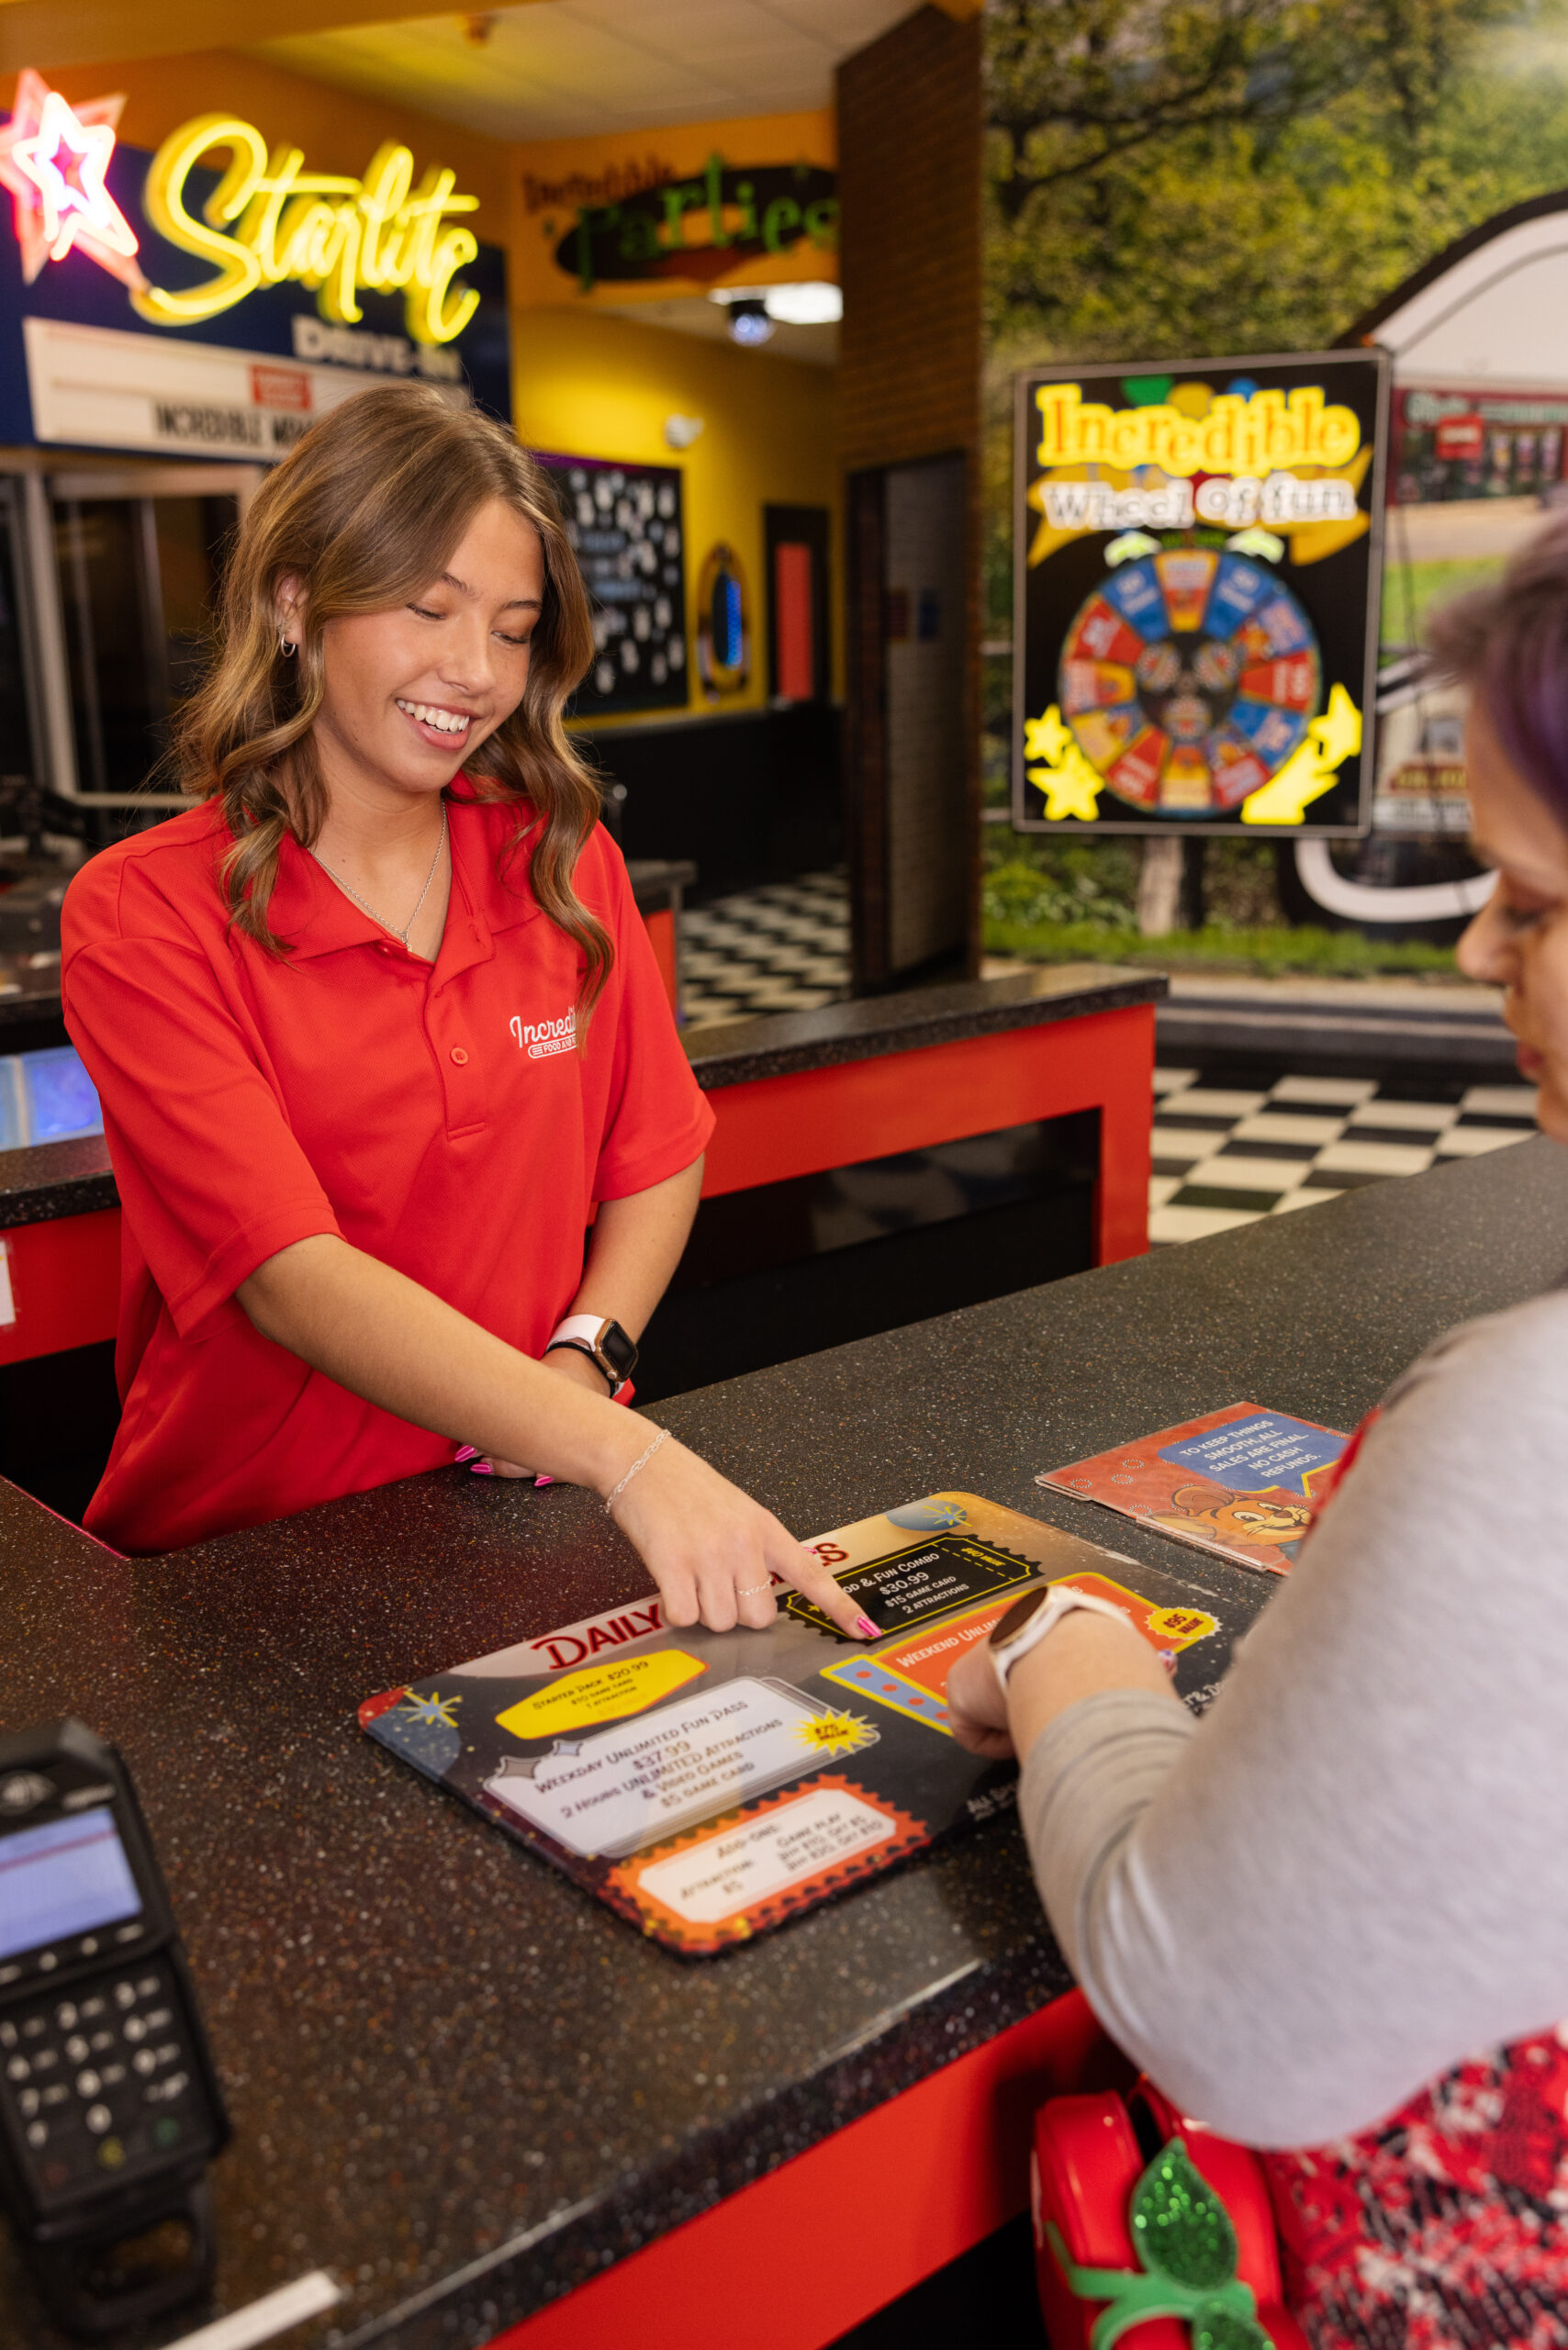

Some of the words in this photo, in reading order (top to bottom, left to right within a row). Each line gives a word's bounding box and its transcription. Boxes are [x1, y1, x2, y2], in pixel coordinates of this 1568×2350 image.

[131, 112, 480, 343] Starlite
[1036, 383, 1361, 477] Incredible
[1039, 478, 1194, 531] Wheel
[1262, 471, 1358, 524] fun
[510, 1005, 577, 1048] Incredi
[543, 1041, 561, 1053] FOOD
[1179, 1448, 1201, 1457] TO
[1199, 1436, 1229, 1450] KEEP
[1227, 1420, 1274, 1438] THINGS
[1204, 1438, 1260, 1460] SMOOTH,
[1260, 1429, 1283, 1441] ALL
[1209, 1454, 1249, 1472] SALES
[1247, 1446, 1273, 1459] ARE
[1270, 1433, 1309, 1449] FINAL.
[1248, 1460, 1271, 1470] NO
[1269, 1447, 1304, 1462] CASH
[1260, 1453, 1322, 1478] REFUNDS.
[842, 1583, 860, 1595] OD
[859, 1576, 876, 1588] &
[873, 1567, 898, 1583] FUN
[898, 1552, 940, 1573] COMBO
[879, 1571, 930, 1595] $30.99
[885, 1594, 907, 1608] $15
[907, 1584, 933, 1600] GAME
[932, 1575, 957, 1589] CARD
[902, 1605, 914, 1615] 2
[913, 1583, 970, 1610] ATTRACTIONS
[530, 1603, 664, 1671] DAILY
[1163, 1614, 1187, 1628] $95
[1178, 1617, 1204, 1634] VALUE
[896, 1638, 959, 1667] WEEKEND
[958, 1617, 1002, 1641] UNLIM
[607, 1661, 649, 1682] $20.99
[534, 1760, 603, 1795] WEEKDAY
[606, 1729, 679, 1764] UNLIMITED
[681, 1717, 710, 1734] FUN
[709, 1701, 748, 1721] PASS
[633, 1740, 691, 1771] $37.99
[560, 1806, 573, 1819] 2
[575, 1786, 622, 1813] HOURS
[622, 1750, 703, 1793] UNLIMITED
[705, 1718, 783, 1756] ATTRACTIONS
[642, 1787, 657, 1800] &
[656, 1768, 696, 1792] VIDEO
[696, 1751, 744, 1775] GAMES
[660, 1794, 682, 1808] $5
[683, 1777, 720, 1797] GAME
[720, 1762, 755, 1781] CARD
